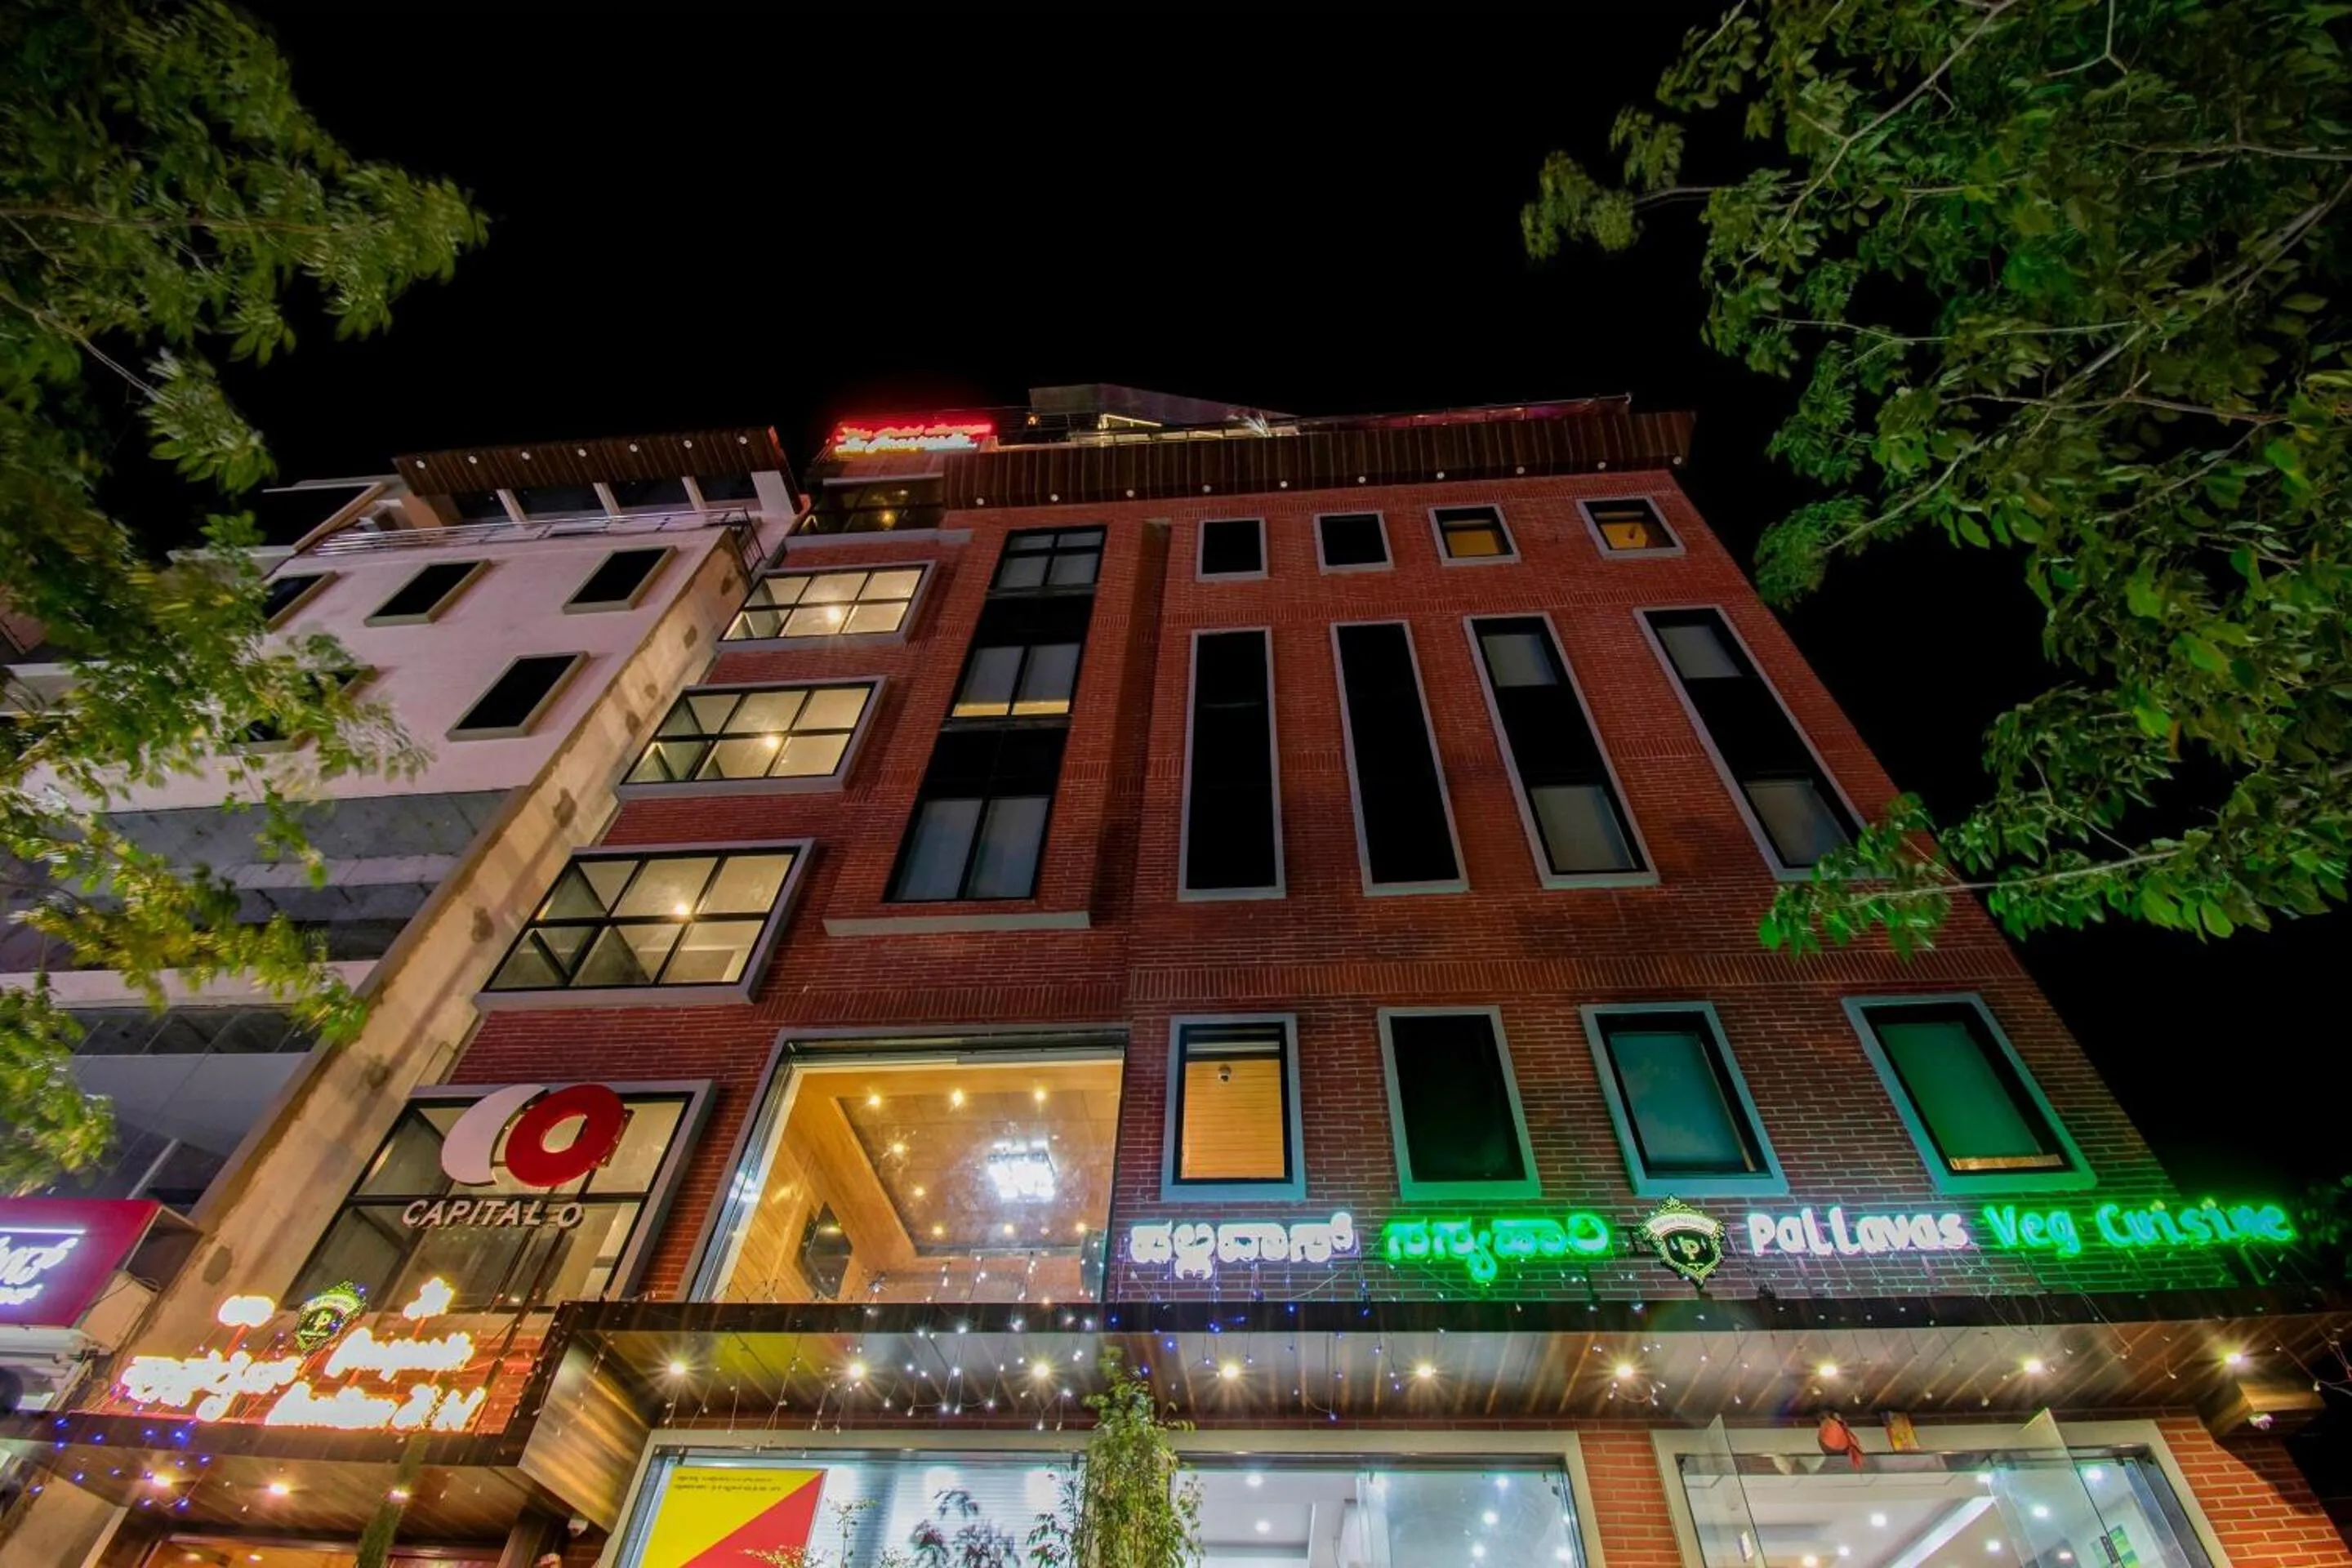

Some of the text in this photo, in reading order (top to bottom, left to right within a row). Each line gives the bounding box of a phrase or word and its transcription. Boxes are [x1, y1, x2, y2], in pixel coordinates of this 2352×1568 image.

[402, 1200, 584, 1228] CAPITAL O
[1748, 1207, 1968, 1256] Pallavas
[1984, 1205, 2082, 1257] Veg
[2096, 1200, 2293, 1249] Cuisine
